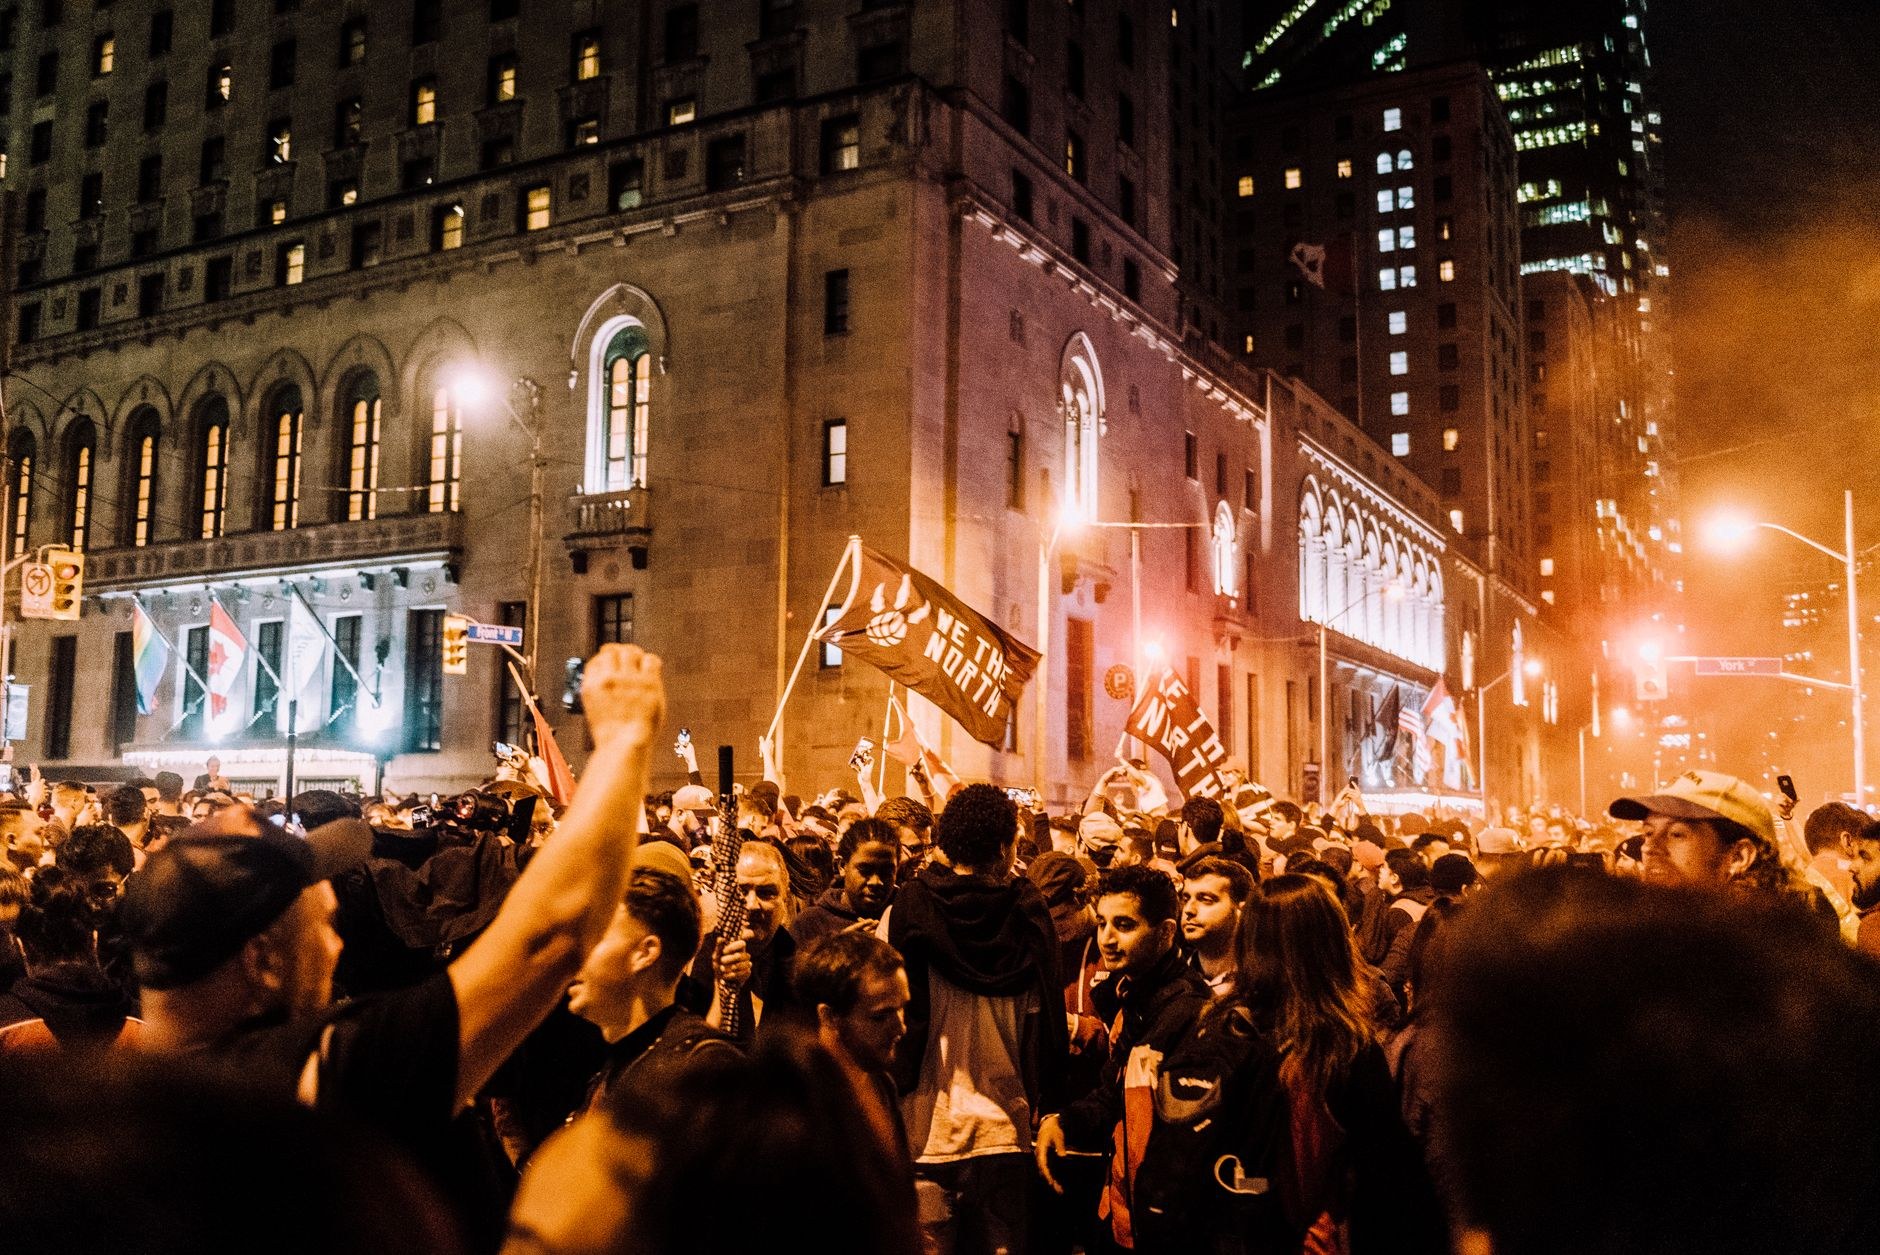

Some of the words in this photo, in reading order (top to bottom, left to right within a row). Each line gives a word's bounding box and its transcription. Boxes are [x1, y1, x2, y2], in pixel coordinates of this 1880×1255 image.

[923, 631, 1002, 718] NORTH
[937, 608, 970, 648] WE
[974, 635, 1013, 690] THE
[1114, 672, 1127, 689] P
